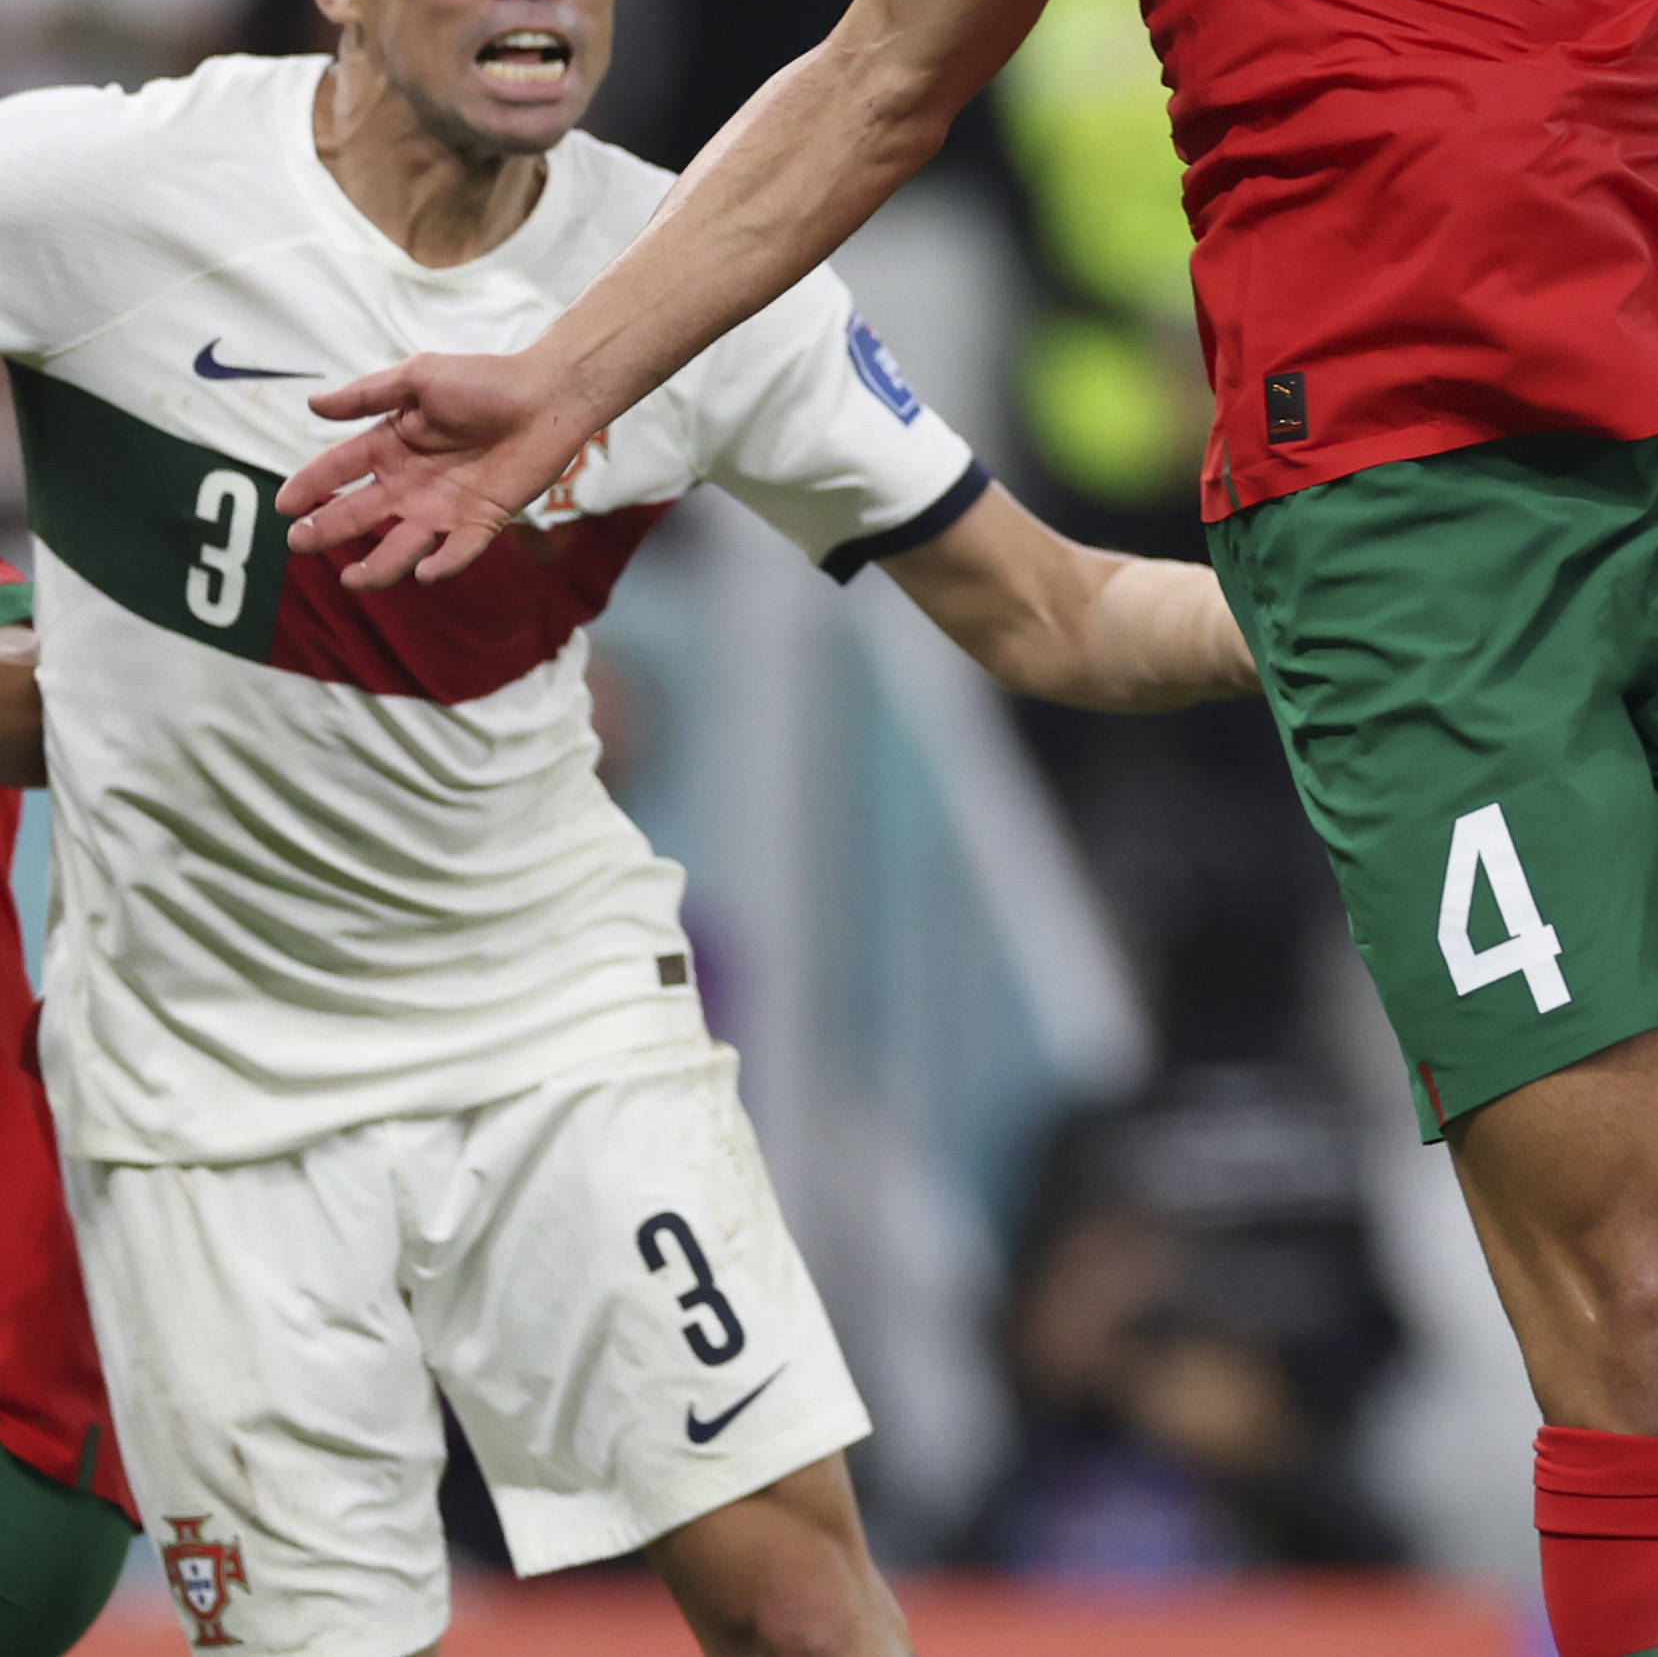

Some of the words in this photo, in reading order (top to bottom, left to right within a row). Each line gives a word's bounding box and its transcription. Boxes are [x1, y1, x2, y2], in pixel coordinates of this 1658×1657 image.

[186, 468, 259, 629] 3
[1438, 802, 1572, 1014] 4
[637, 1210, 745, 1366] 3
